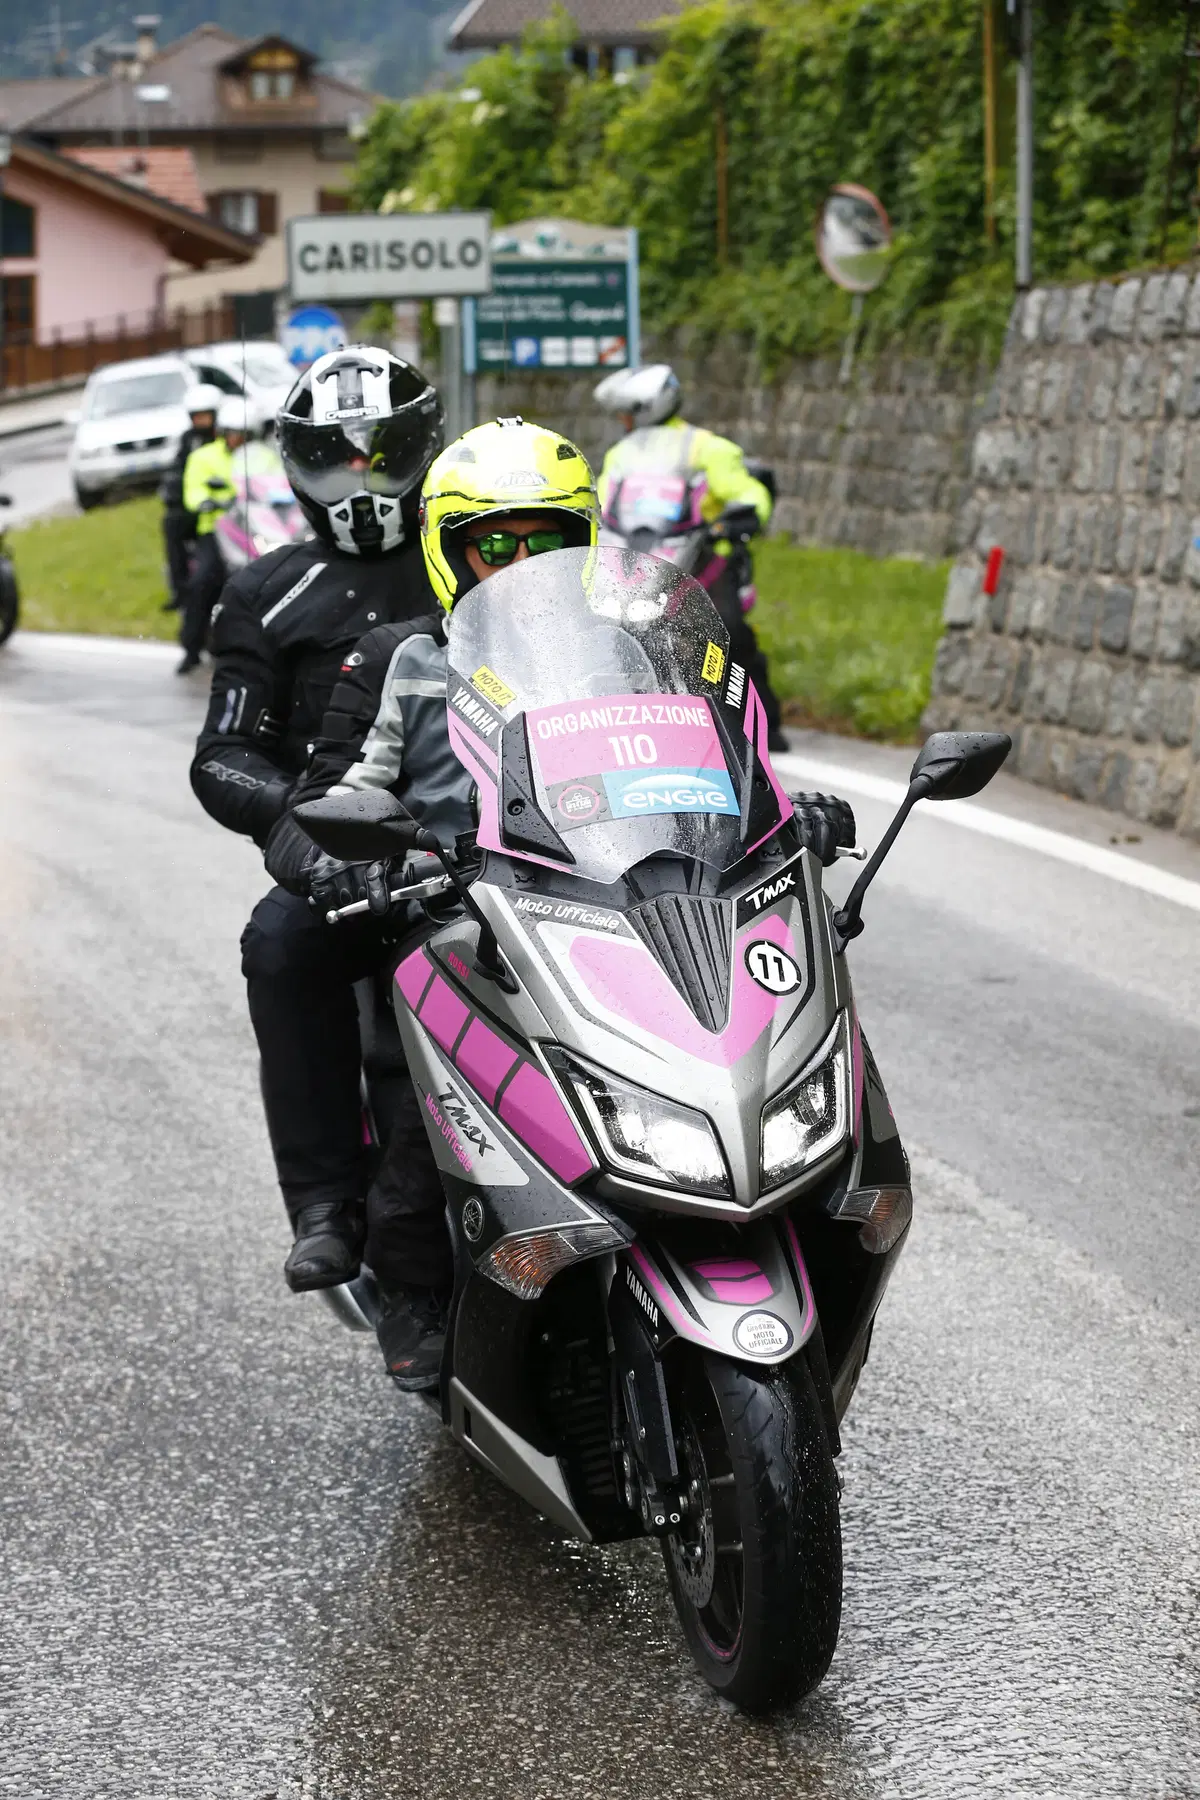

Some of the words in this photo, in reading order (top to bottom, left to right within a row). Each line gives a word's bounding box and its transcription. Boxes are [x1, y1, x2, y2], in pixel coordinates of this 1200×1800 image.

[299, 237, 482, 274] CARISOLO
[706, 645, 720, 680] MOTO.IT
[477, 672, 511, 701] MOTO.IT
[725, 661, 746, 709] YAMAHA
[451, 686, 499, 737] YAMAHA
[536, 705, 711, 740] ORGANIZZAZIONE
[608, 733, 658, 766] 110
[745, 872, 795, 910] TMAX
[514, 897, 553, 915] Moto
[554, 904, 620, 929] Ufficiale
[757, 952, 786, 982] 11
[425, 1092, 443, 1126] Moto
[441, 1120, 473, 1173] Ufficiale
[626, 1265, 659, 1328] YAMAHA
[748, 1337, 783, 1349] UFFICIALE
[753, 1330, 774, 1340] MOTO
